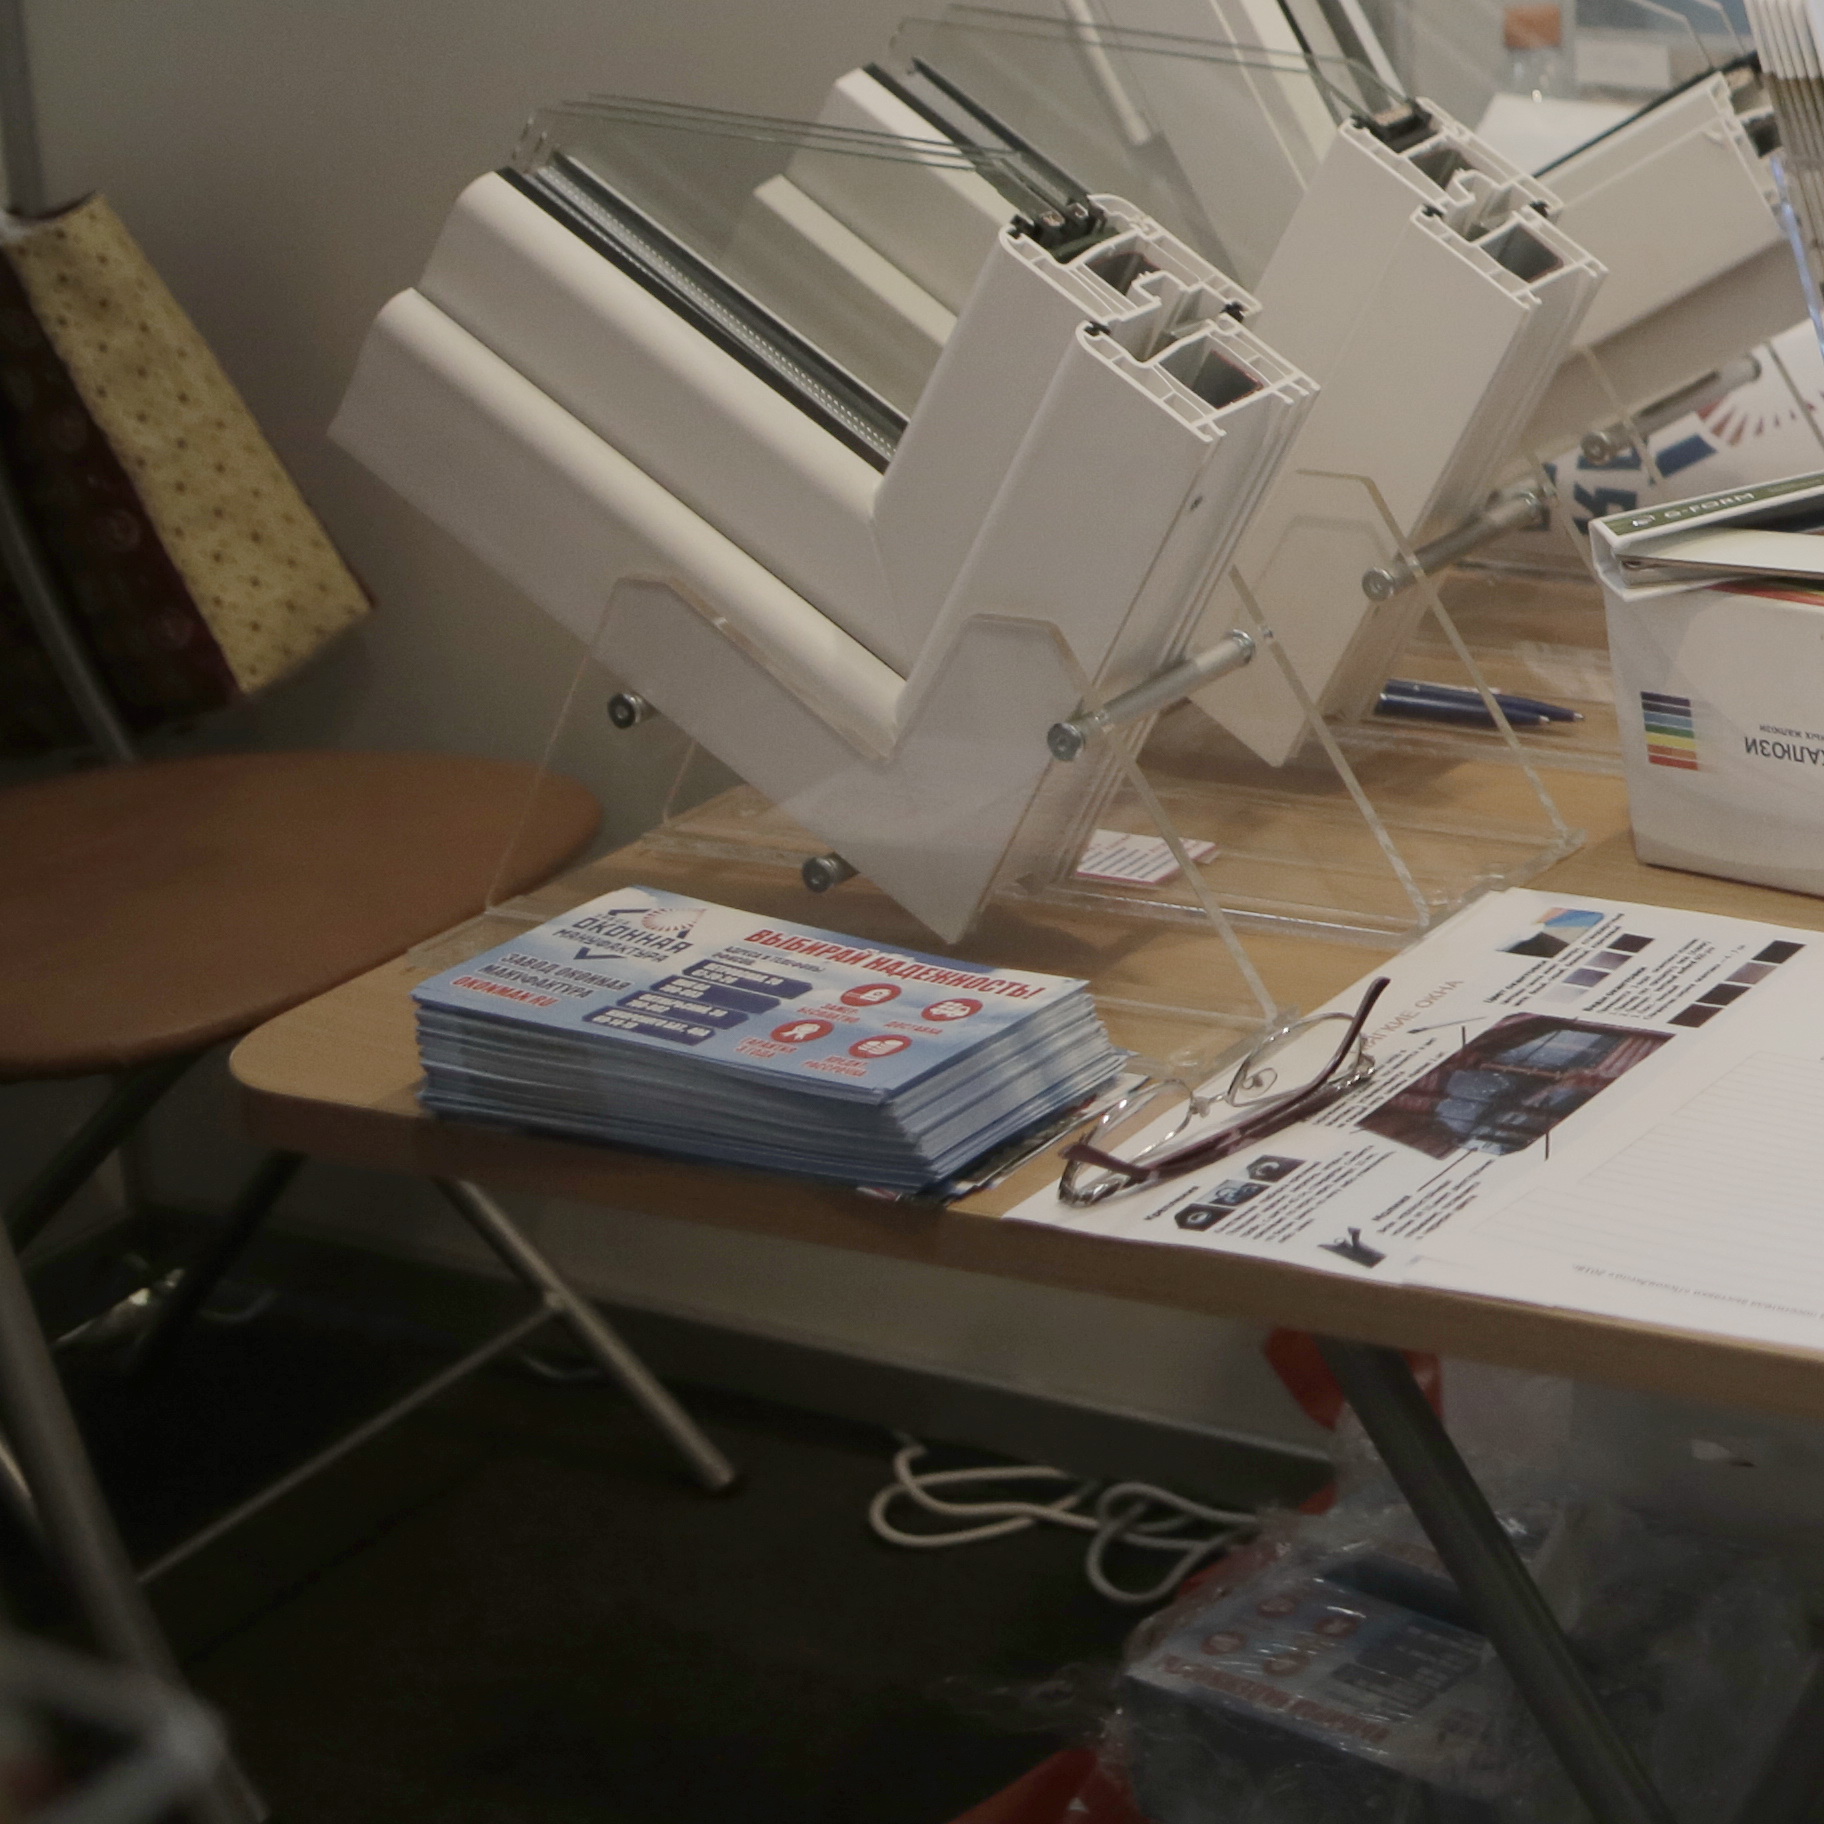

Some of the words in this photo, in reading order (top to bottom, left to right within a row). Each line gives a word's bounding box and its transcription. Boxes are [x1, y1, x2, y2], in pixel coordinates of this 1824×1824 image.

[551, 929, 670, 962] МАНУФАКТУРА
[570, 916, 694, 953] ОКОННАЯ
[476, 963, 597, 998] МАНУФАКТУРА
[498, 953, 561, 973] ЗАВОД
[552, 966, 633, 990] ОКОННАЯ
[742, 929, 878, 965] ВЫБИРАЙ
[858, 956, 1047, 999] НАДЕЖНОСТЬ!
[451, 976, 561, 1007] OKONMAN.RU
[1411, 979, 1463, 1008] ОКНА
